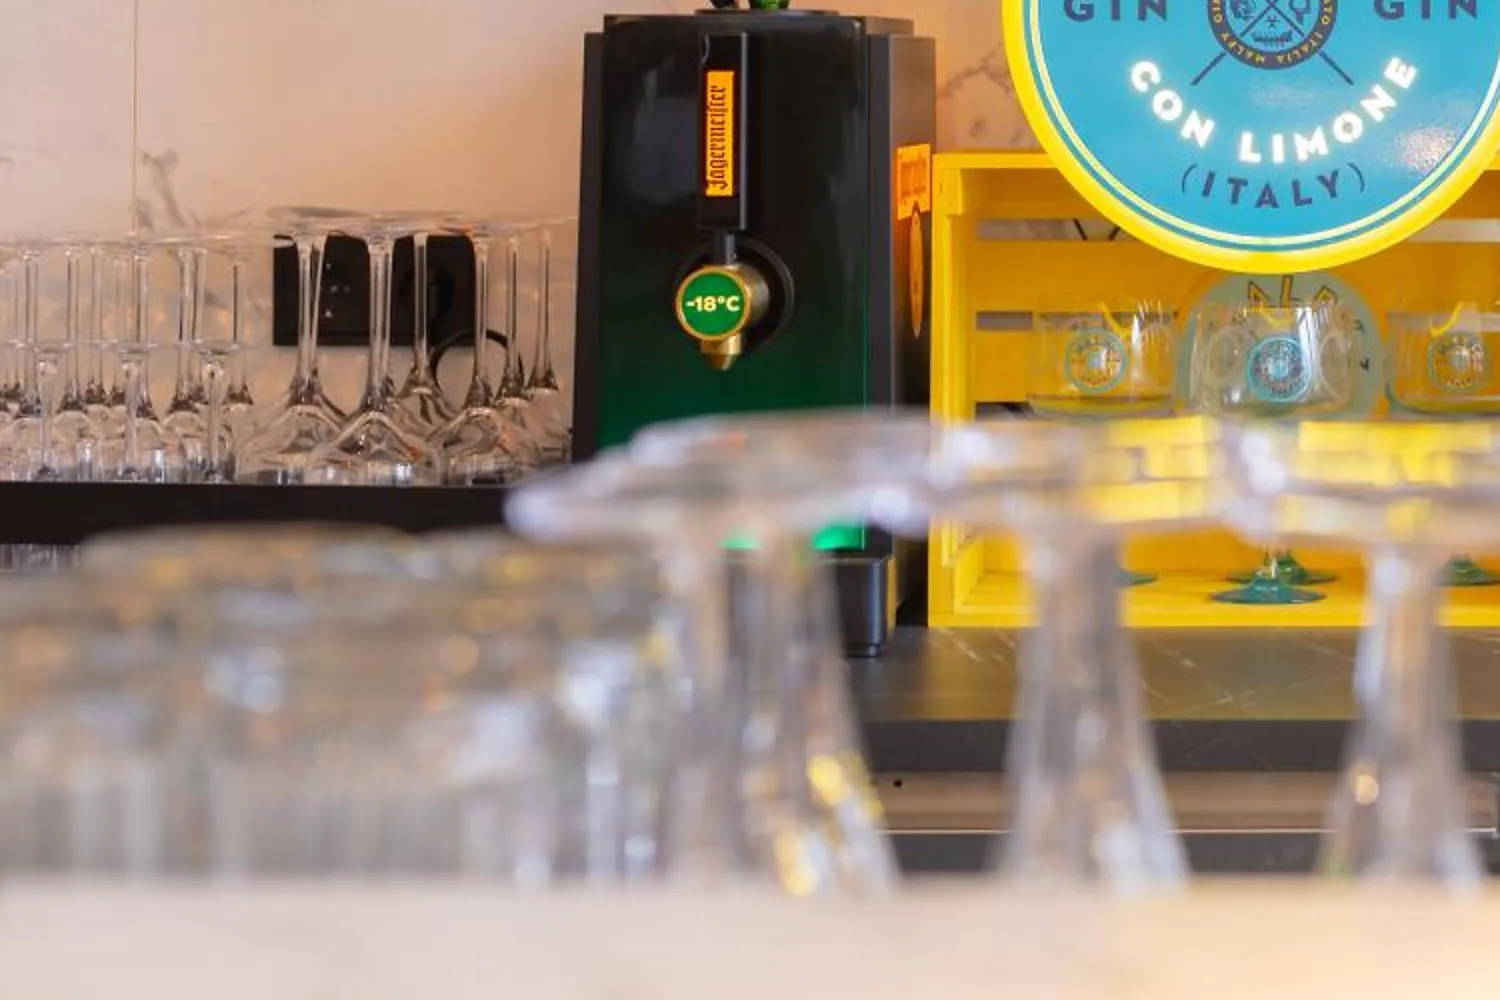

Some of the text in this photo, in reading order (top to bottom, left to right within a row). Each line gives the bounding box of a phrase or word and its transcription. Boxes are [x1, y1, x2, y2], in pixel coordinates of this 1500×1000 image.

[1130, 56, 1419, 164] CON LIMONE
[1181, 162, 1365, 208] (ITALY)
[685, 294, 741, 313] -18°C
